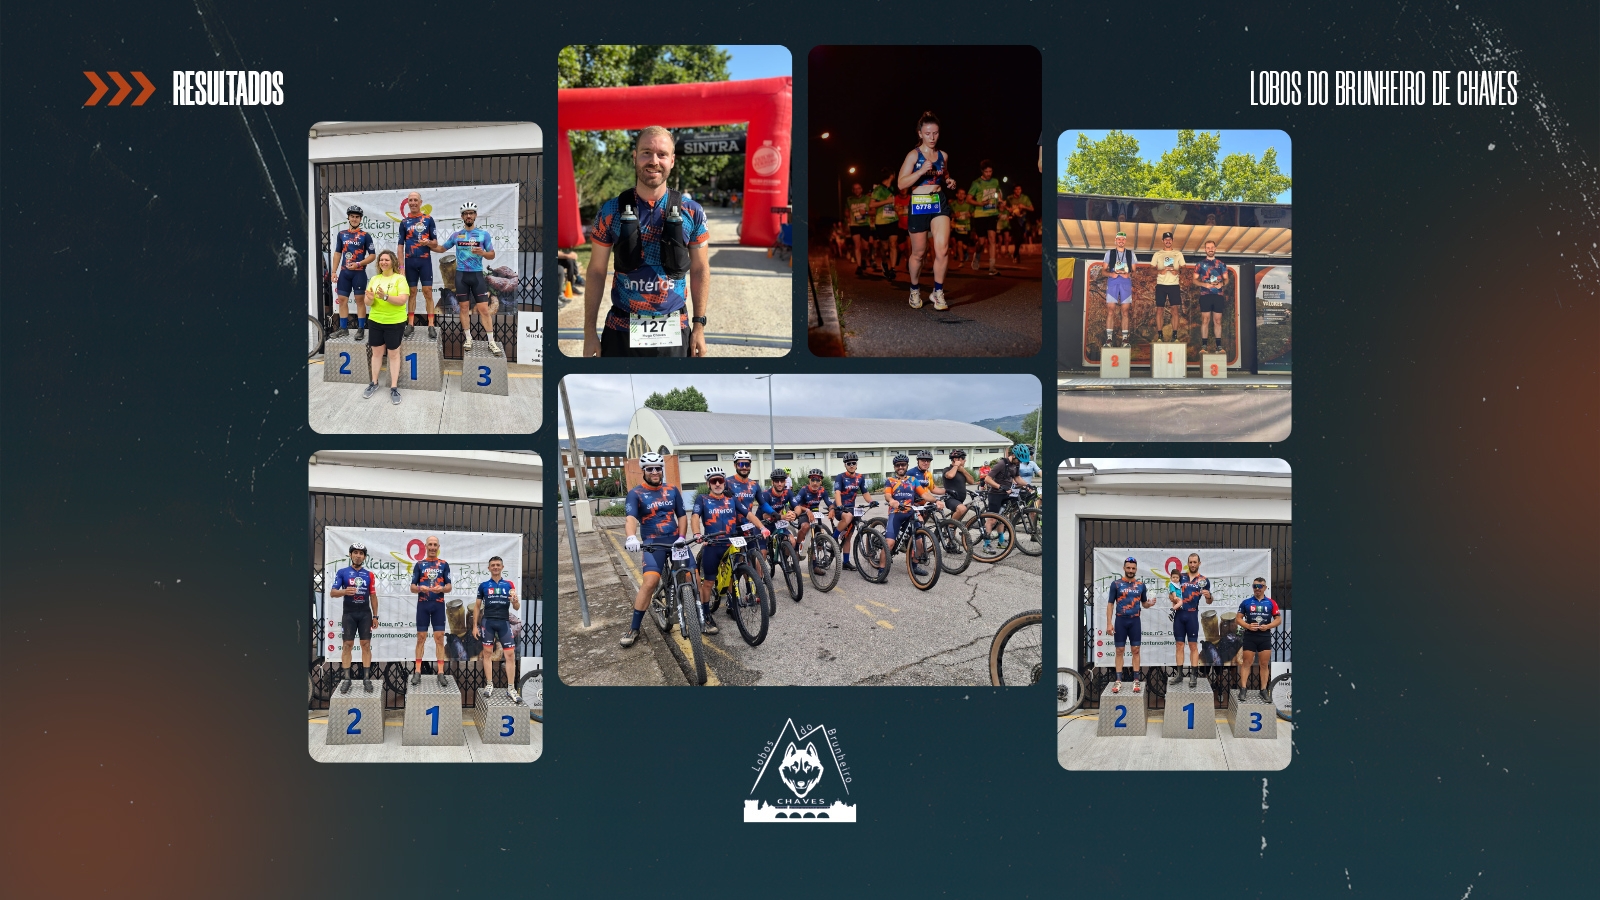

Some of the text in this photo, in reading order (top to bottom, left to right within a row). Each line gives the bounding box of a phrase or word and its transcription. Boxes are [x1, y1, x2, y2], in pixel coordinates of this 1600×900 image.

[684, 140, 740, 154] SINTRA
[624, 278, 675, 292] anteros
[641, 321, 667, 333] 127
[339, 352, 351, 375] 2
[405, 352, 418, 381] 1
[1110, 355, 1119, 367] 2
[1167, 351, 1173, 364] 1
[476, 365, 492, 387] 3
[1210, 363, 1219, 376] 3
[647, 500, 673, 510] anteros
[346, 707, 362, 735] 2
[425, 705, 440, 736] 1
[500, 715, 515, 737] 3
[1114, 704, 1127, 728] 2
[1182, 702, 1195, 730] 1
[1249, 711, 1263, 732] 3
